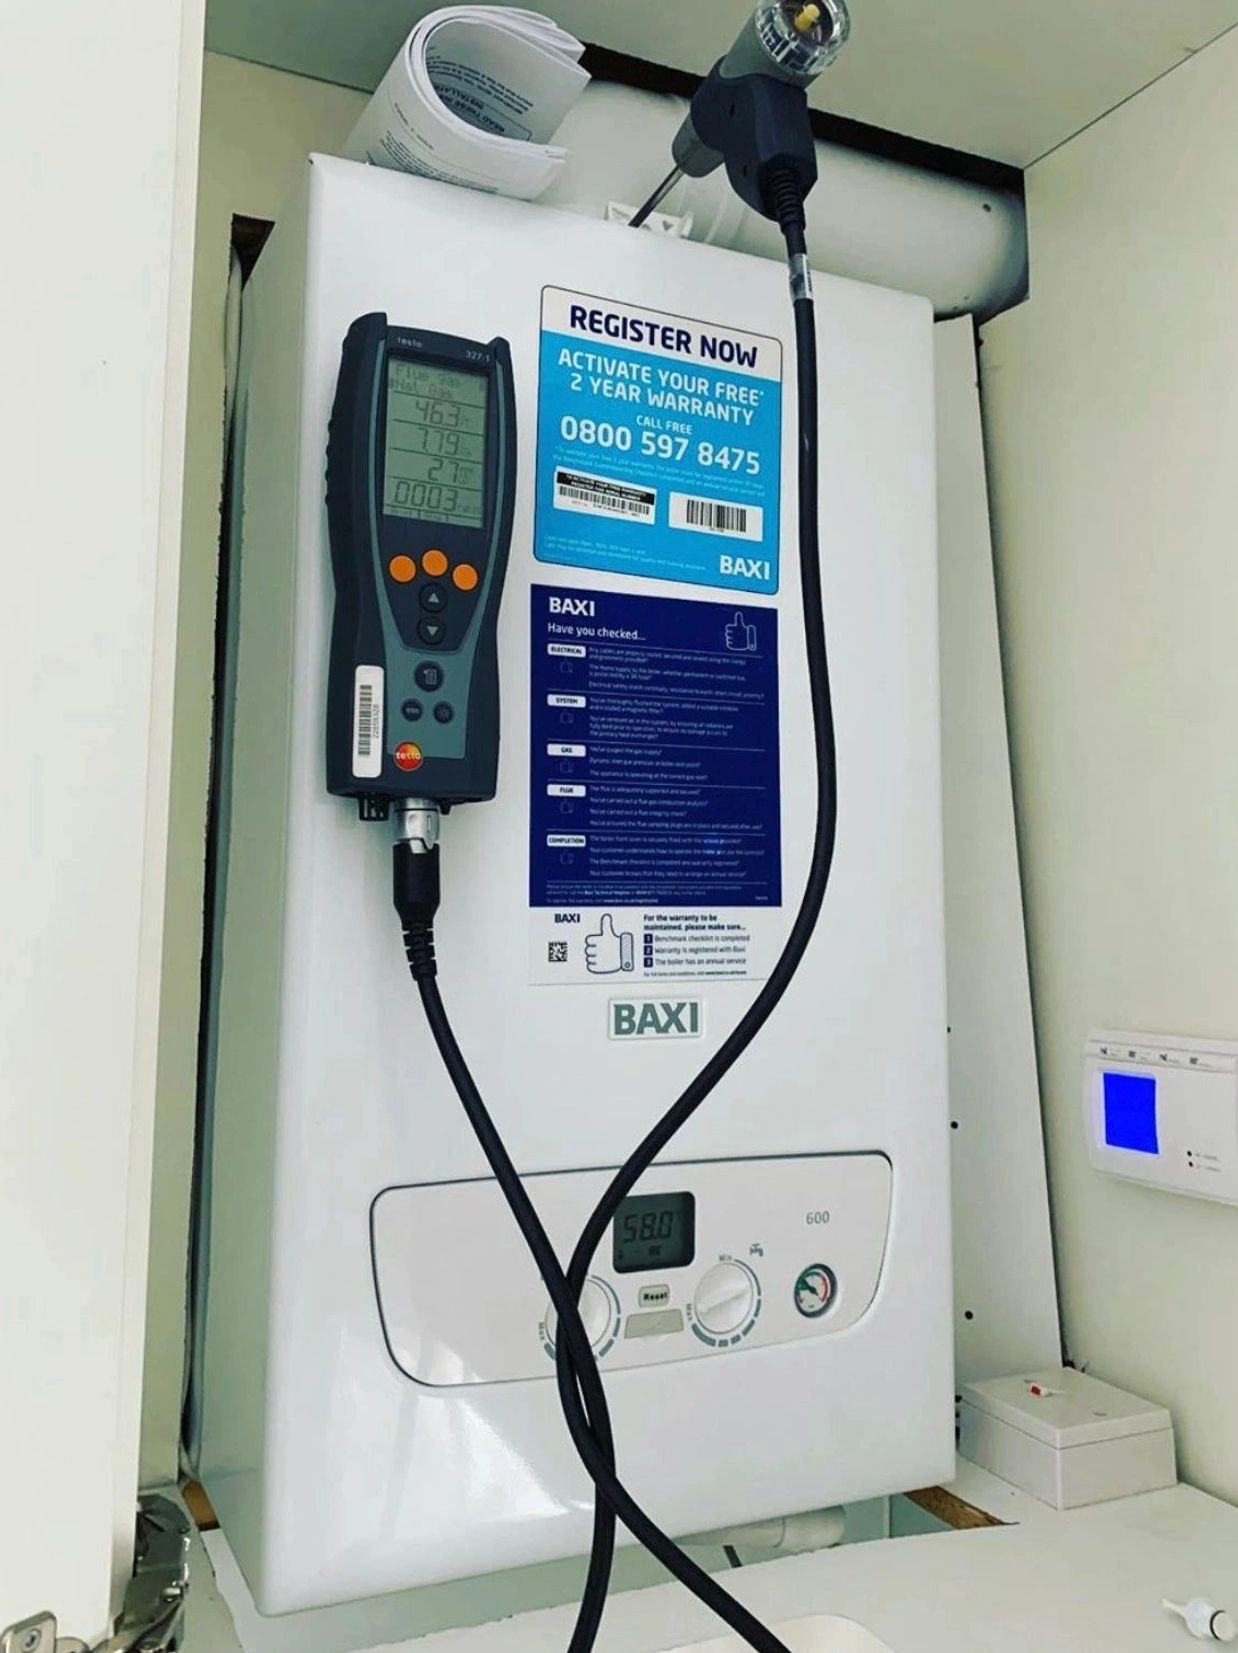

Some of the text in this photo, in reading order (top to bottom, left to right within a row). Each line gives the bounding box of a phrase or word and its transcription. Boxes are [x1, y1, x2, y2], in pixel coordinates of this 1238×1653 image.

[569, 304, 758, 369] REGISTER NOW
[558, 348, 652, 384] ACTIVATE
[657, 368, 710, 397] YOUR
[570, 372, 754, 427] 2 YEAR WARRANTY
[636, 414, 693, 436] CALL FREE
[560, 414, 632, 451] 0800
[640, 431, 689, 462] 597
[697, 442, 760, 475] 8475
[428, 457, 459, 483] 27
[719, 554, 771, 581] BAXI
[548, 596, 595, 617] BAXI
[547, 622, 574, 635] Have
[576, 626, 595, 638] you
[396, 751, 421, 761] testo
[549, 836, 585, 846] COMPLETION
[554, 913, 581, 923] BAXI
[643, 914, 654, 922] For
[656, 914, 668, 922] the
[669, 914, 699, 922] warranty
[685, 924, 706, 932] please
[721, 935, 751, 943] completed
[689, 946, 718, 954] registered
[726, 957, 747, 965] service
[613, 1002, 699, 1036] BAXI
[806, 1210, 830, 1225] 600
[643, 1291, 668, 1301] Reset
